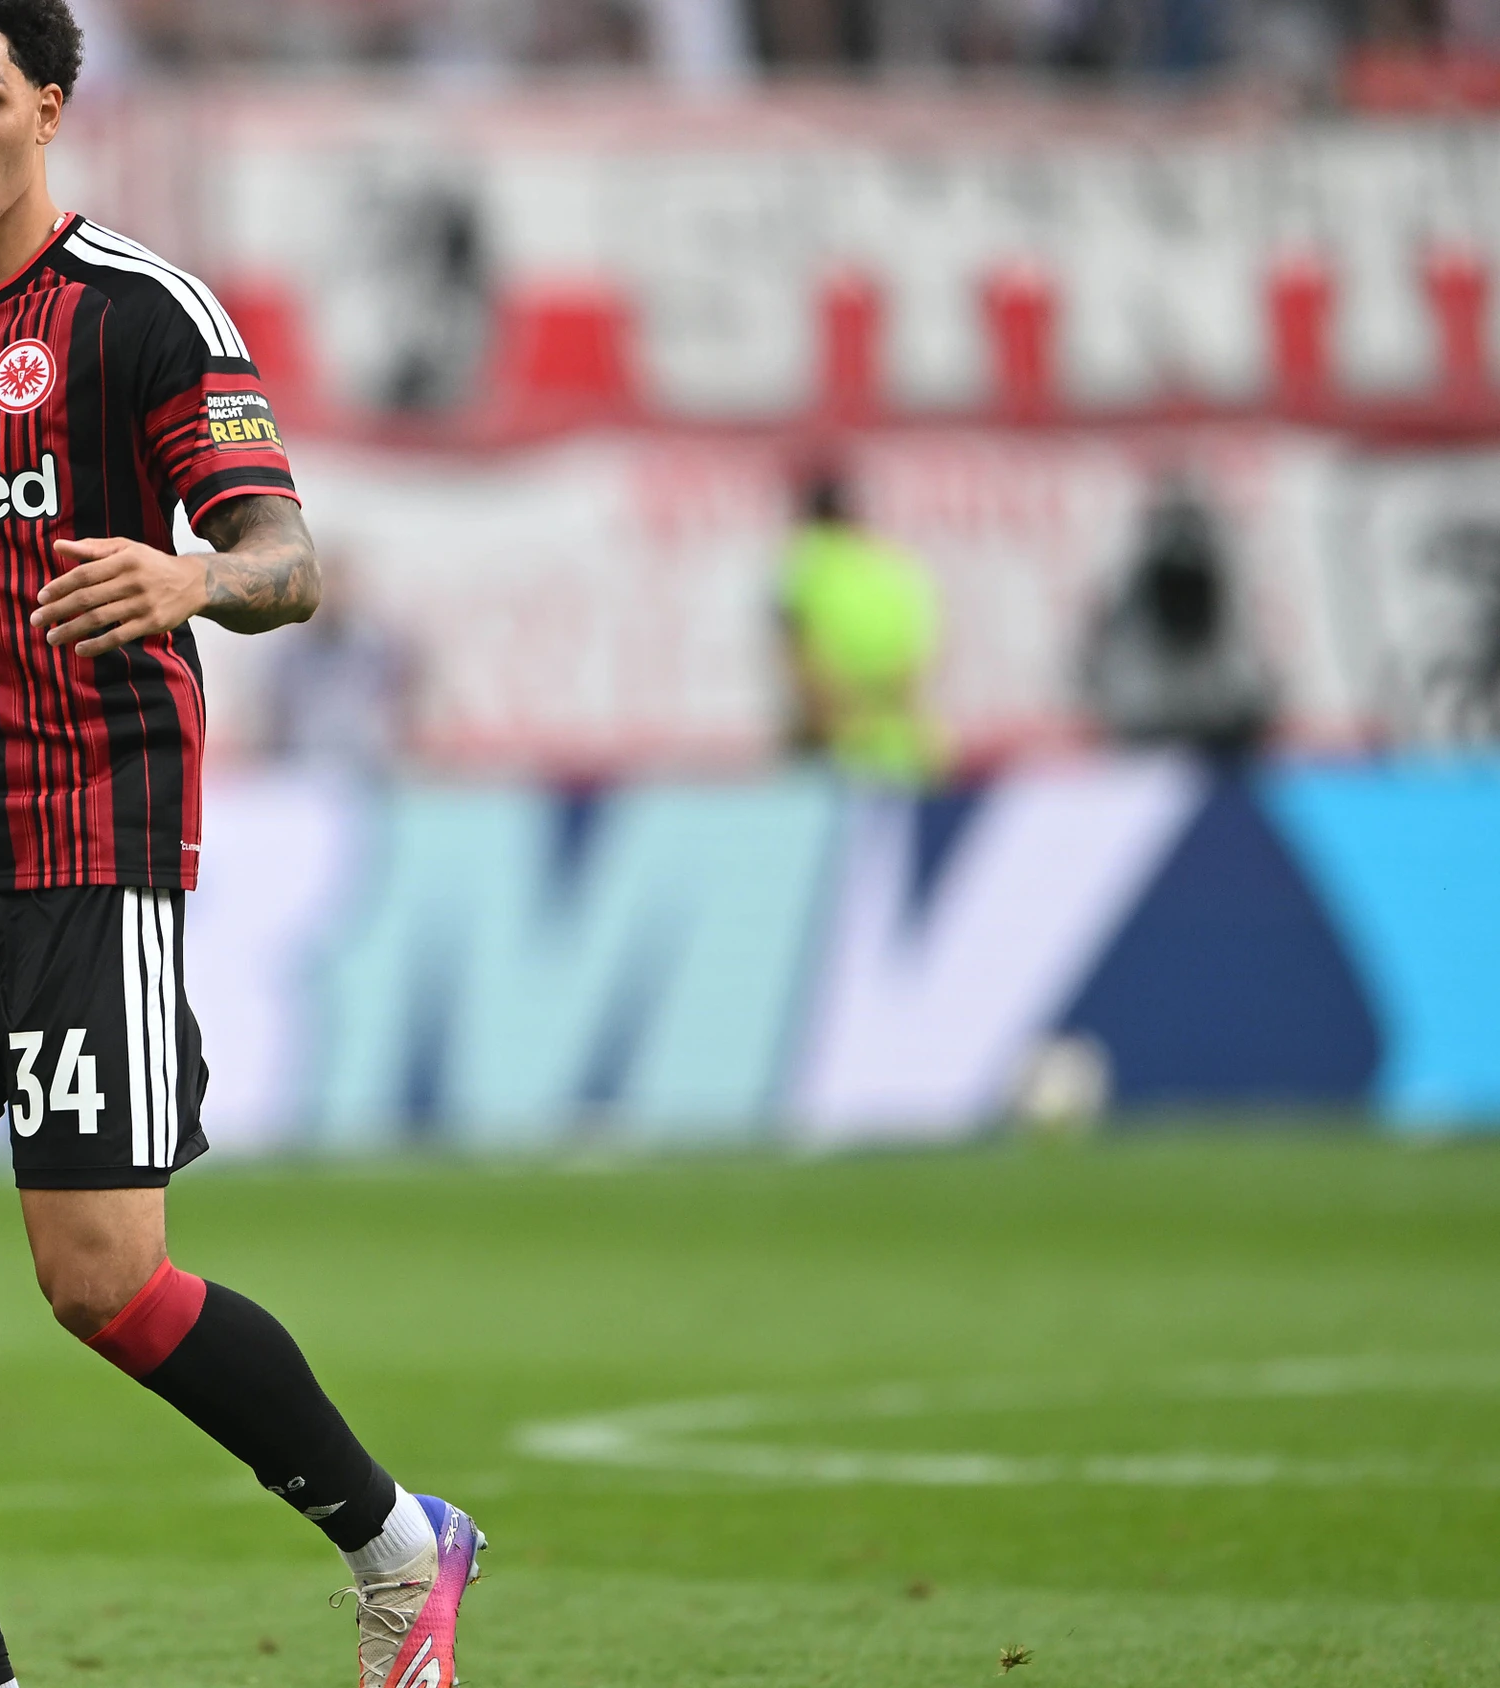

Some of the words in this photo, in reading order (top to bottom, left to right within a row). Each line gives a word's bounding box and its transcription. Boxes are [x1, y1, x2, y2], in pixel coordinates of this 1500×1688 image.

[208, 407, 243, 419] MACHT
[210, 418, 282, 446] RENTE.
[8, 1028, 106, 1138] 34
